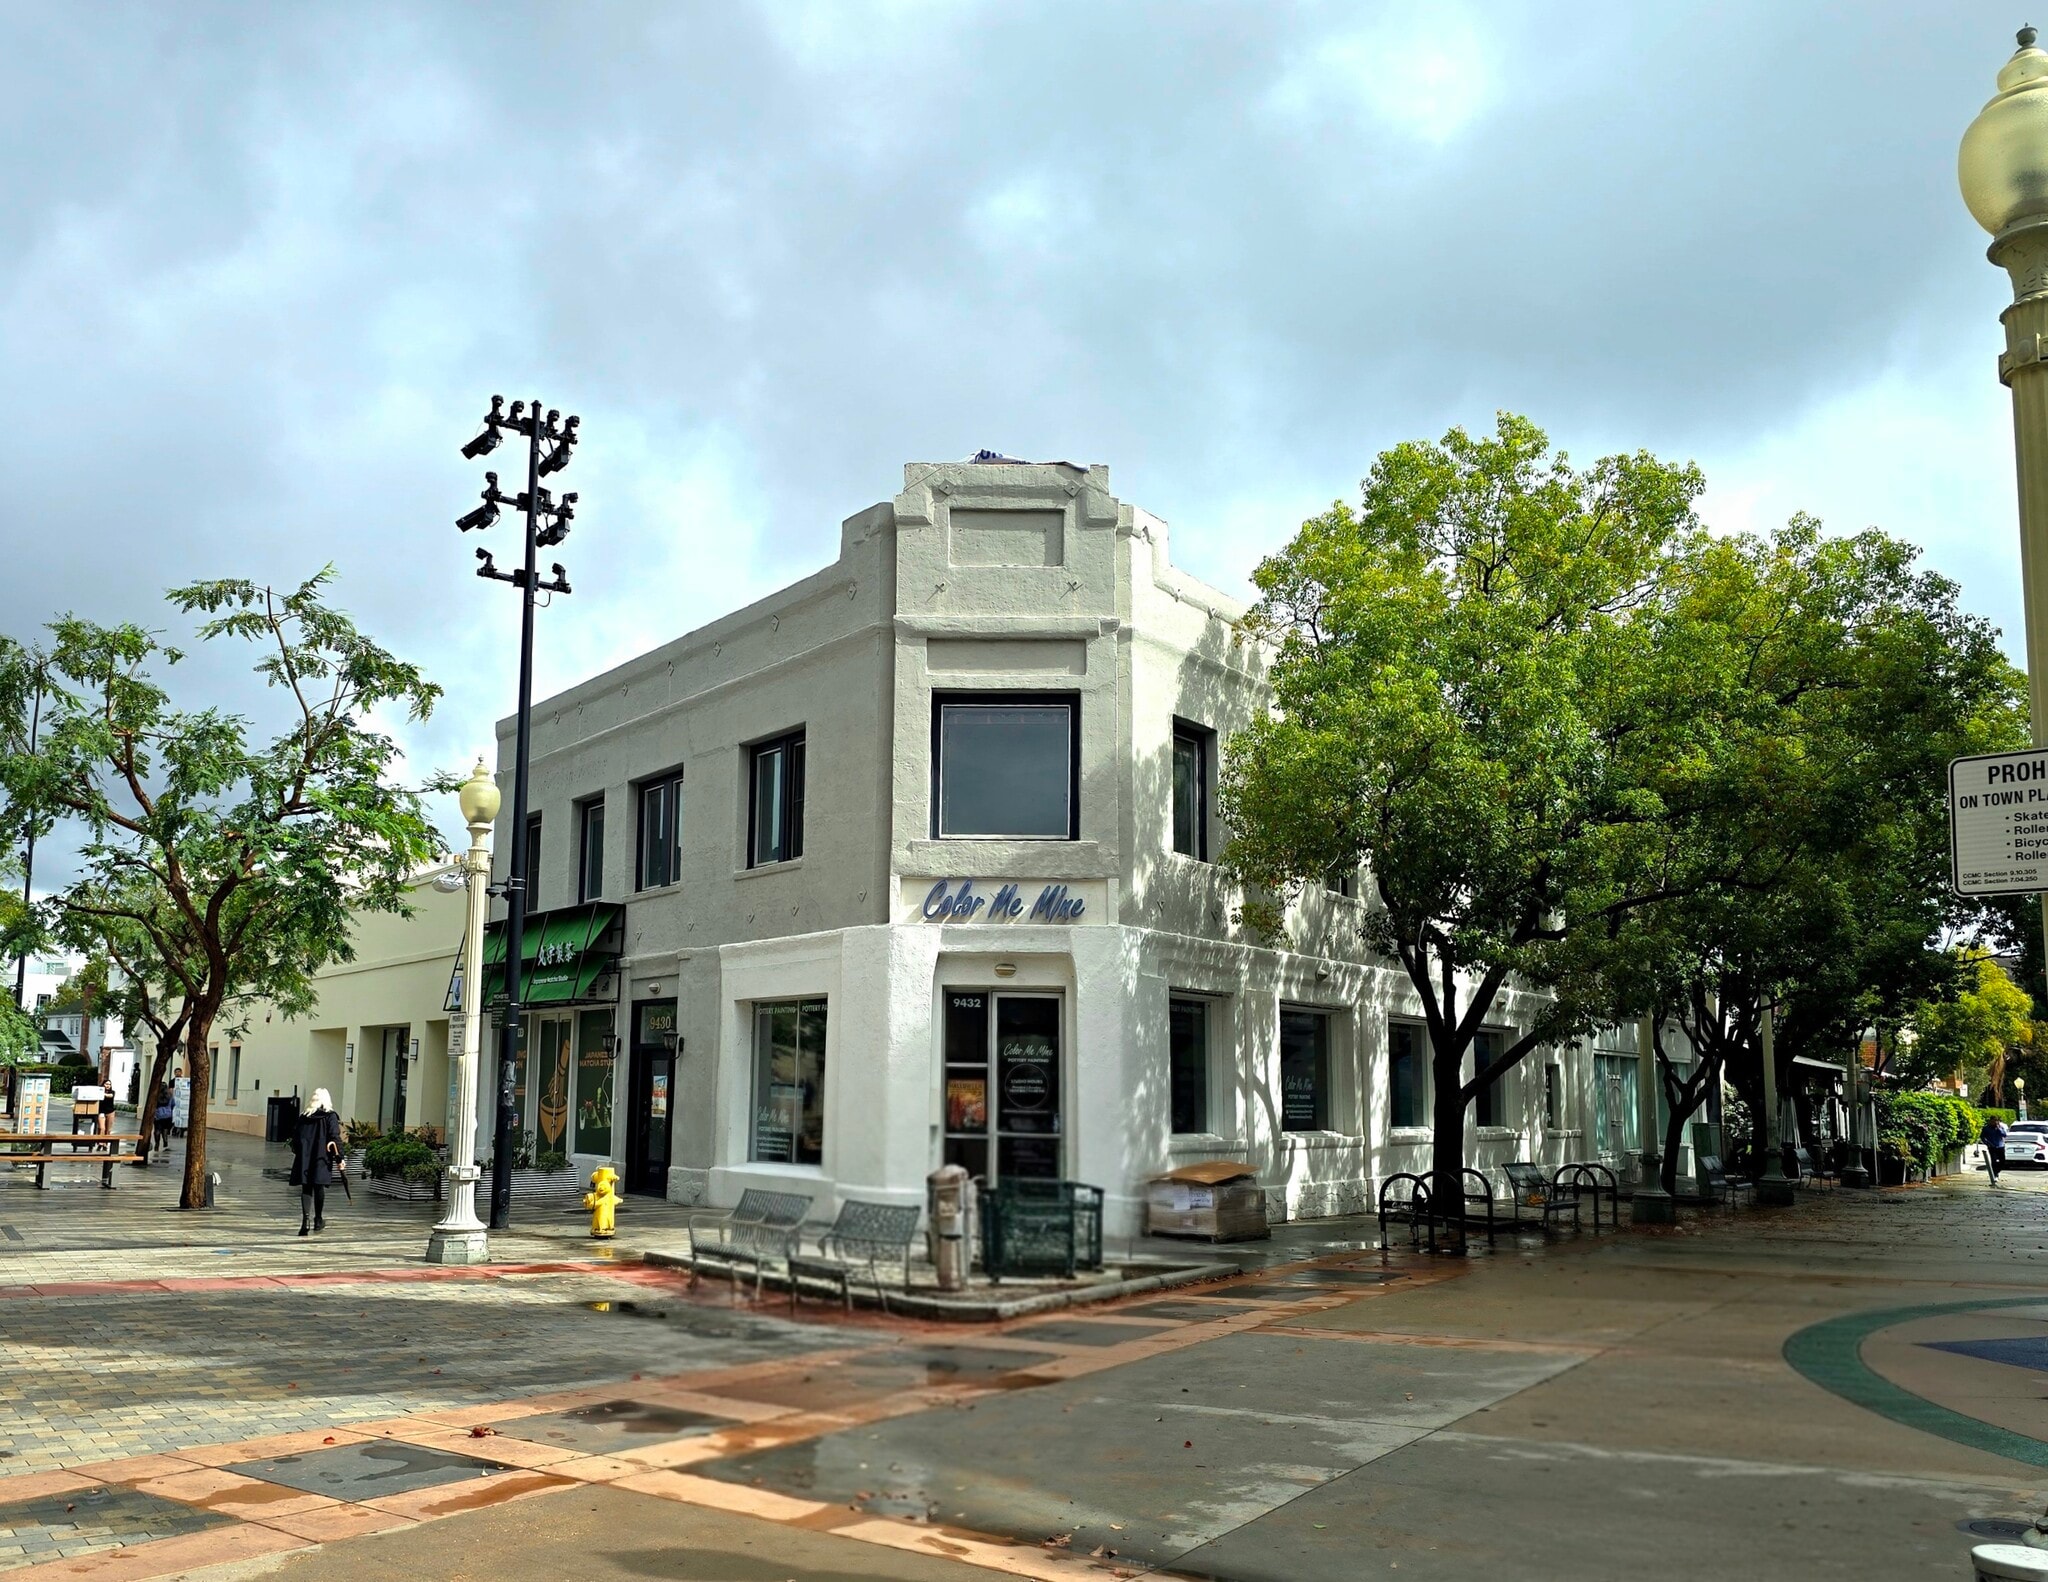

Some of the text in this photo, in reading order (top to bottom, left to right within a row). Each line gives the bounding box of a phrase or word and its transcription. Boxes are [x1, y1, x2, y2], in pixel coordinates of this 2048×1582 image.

[1988, 760, 2046, 785] PROH
[1960, 788, 2048, 809] ON TOWN PL
[1983, 877, 2008, 885] Section
[923, 878, 1085, 923] Color Me Mine
[802, 1004, 821, 1013] POTTERY
[953, 998, 981, 1008] 9432
[650, 1016, 671, 1030] 9430
[1003, 1042, 1054, 1057] Color Me Mine
